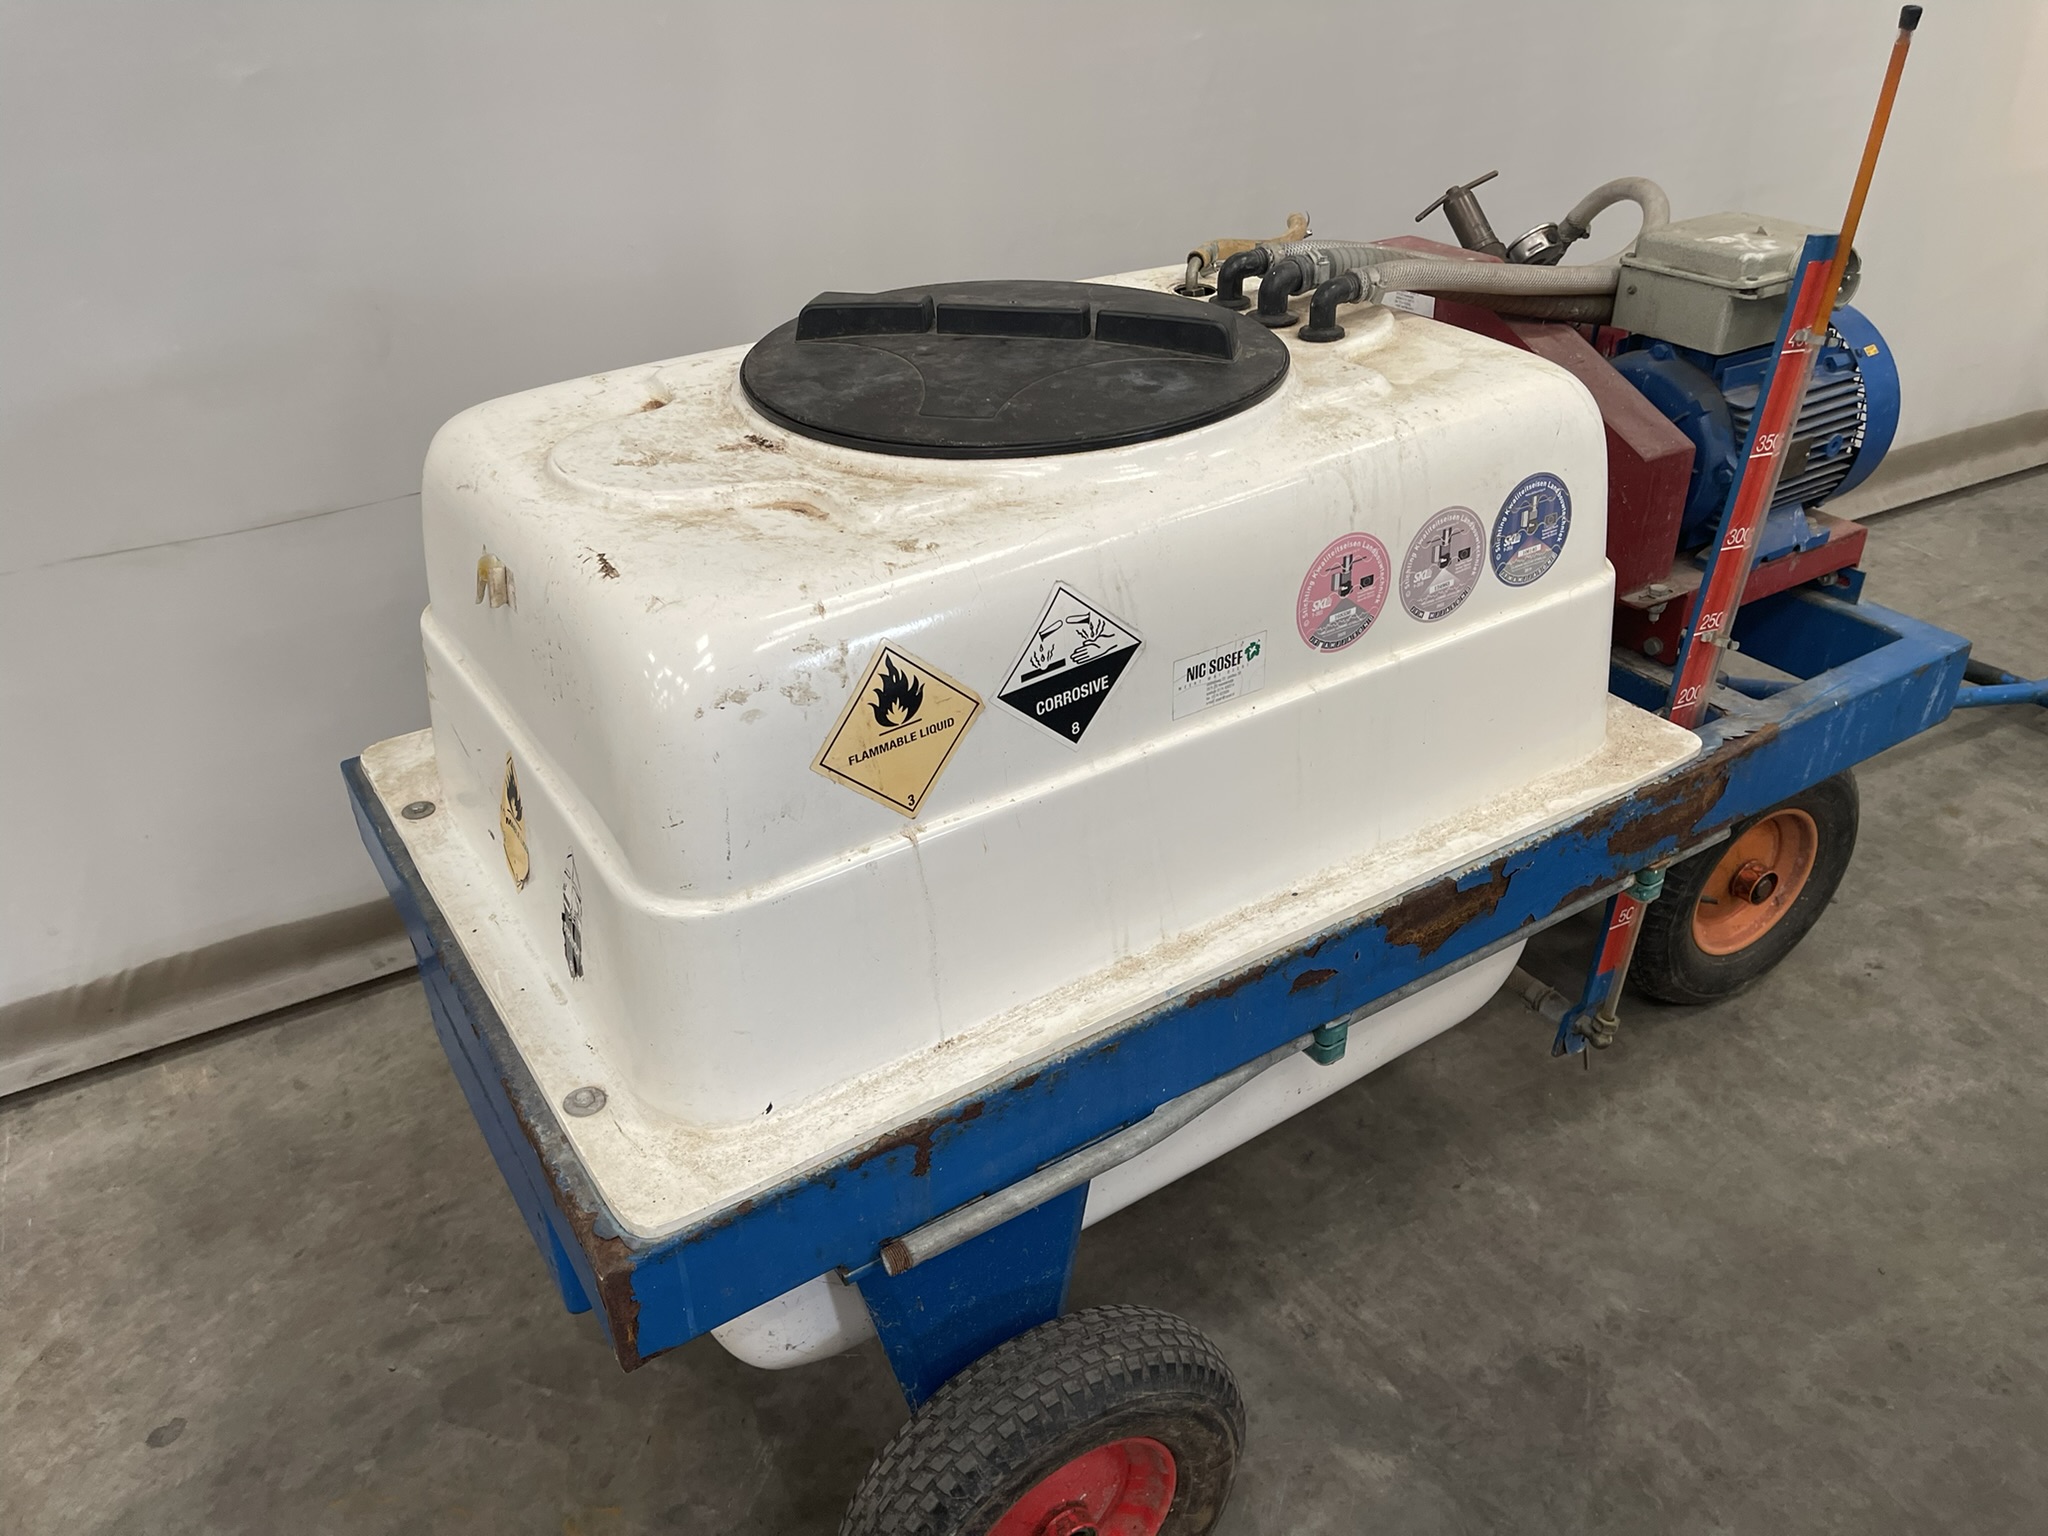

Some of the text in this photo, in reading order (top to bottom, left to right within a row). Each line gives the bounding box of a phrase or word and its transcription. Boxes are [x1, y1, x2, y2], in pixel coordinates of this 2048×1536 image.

[1414, 514, 1461, 551] Kwaliteitseisen
[1495, 516, 1508, 553] Stichting
[1504, 480, 1548, 516] Kwaliteitseisen
[1311, 540, 1362, 579] Kwaliteitseisen
[1186, 662, 1206, 683] NIC
[1208, 649, 1244, 675] SOSEF
[1035, 674, 1110, 716] CORROSIVE
[847, 717, 956, 766] FLAMMABLE LIQUID
[1070, 721, 1081, 735] 8
[906, 793, 917, 807] 3
